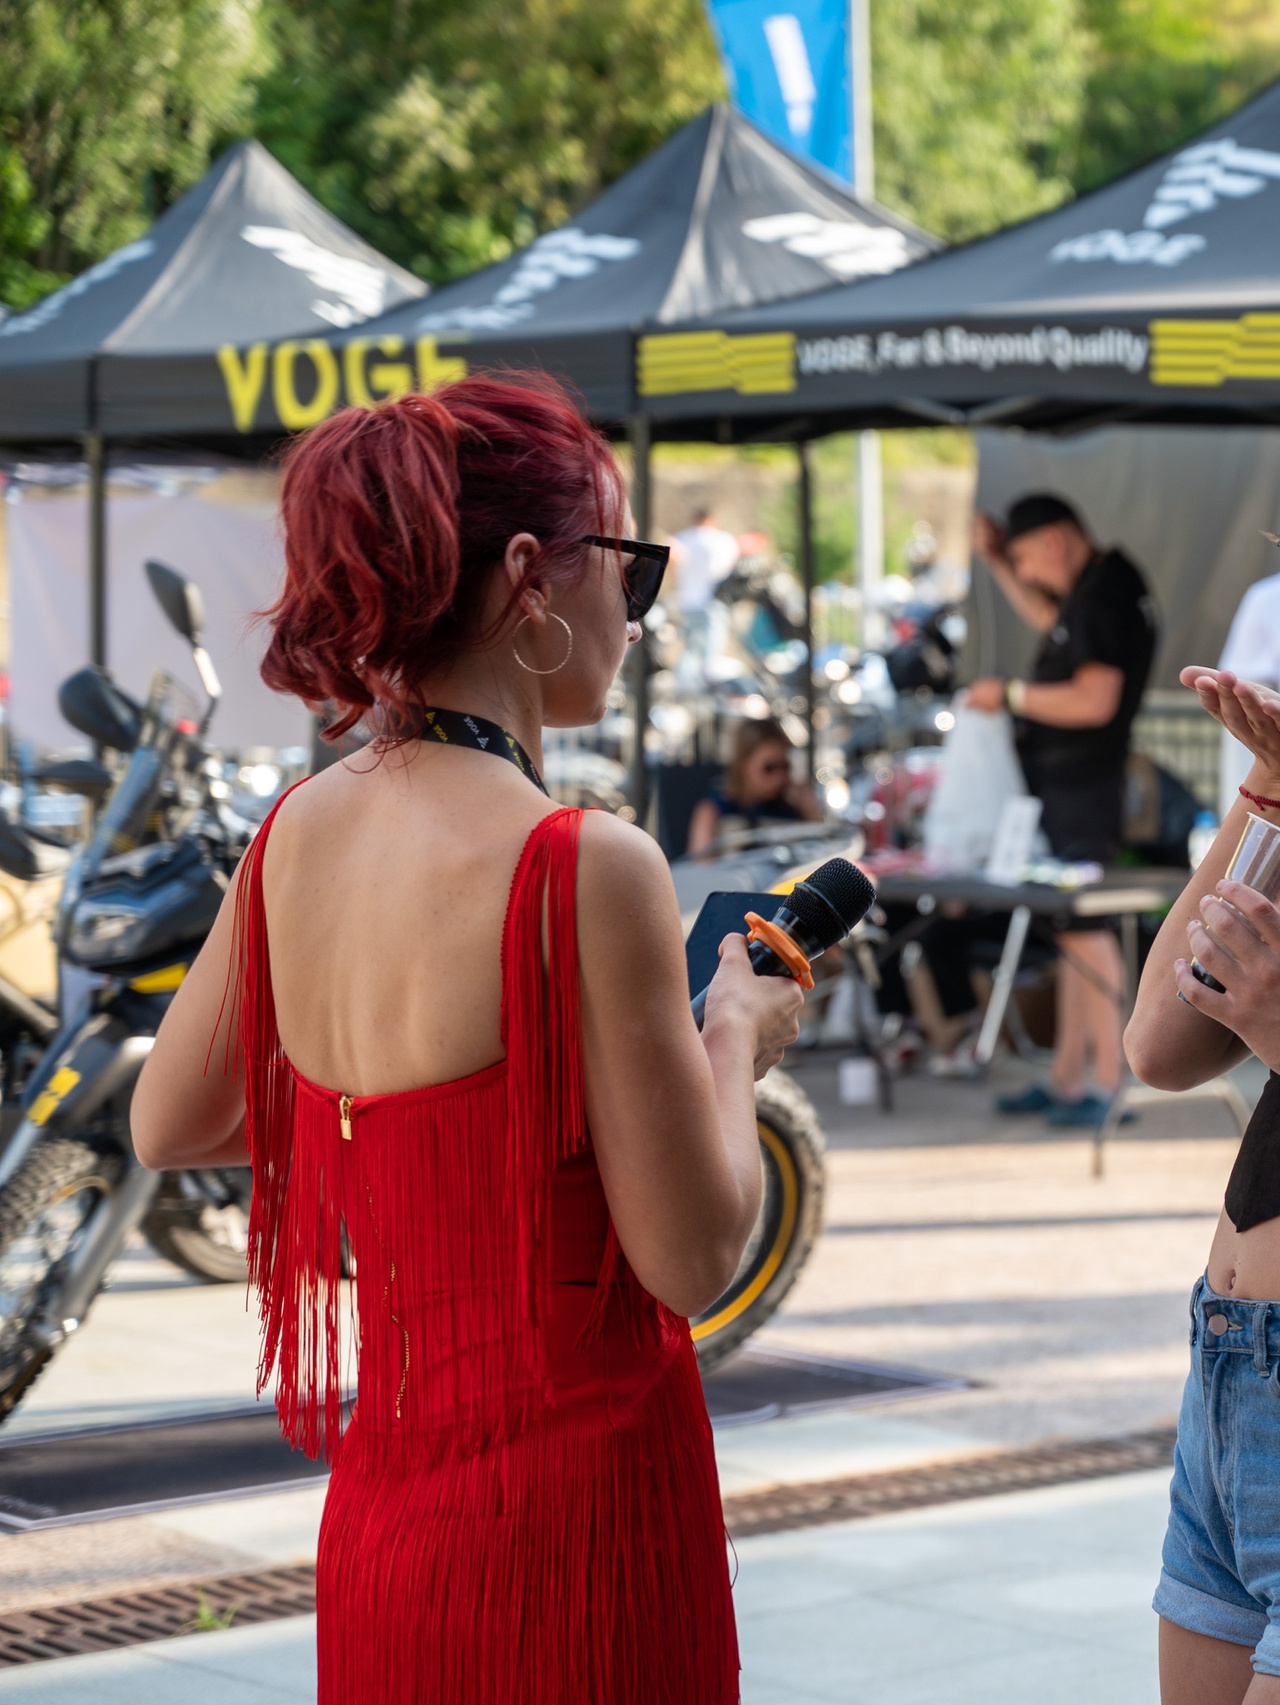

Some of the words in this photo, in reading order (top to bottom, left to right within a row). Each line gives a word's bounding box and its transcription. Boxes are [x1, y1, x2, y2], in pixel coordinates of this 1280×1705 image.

[876, 331, 921, 370] Far
[921, 326, 943, 367] &
[943, 325, 1047, 372] Beyond
[1048, 326, 1149, 374] Quality
[434, 725, 449, 742] VOGE
[464, 717, 480, 735] VOGE
